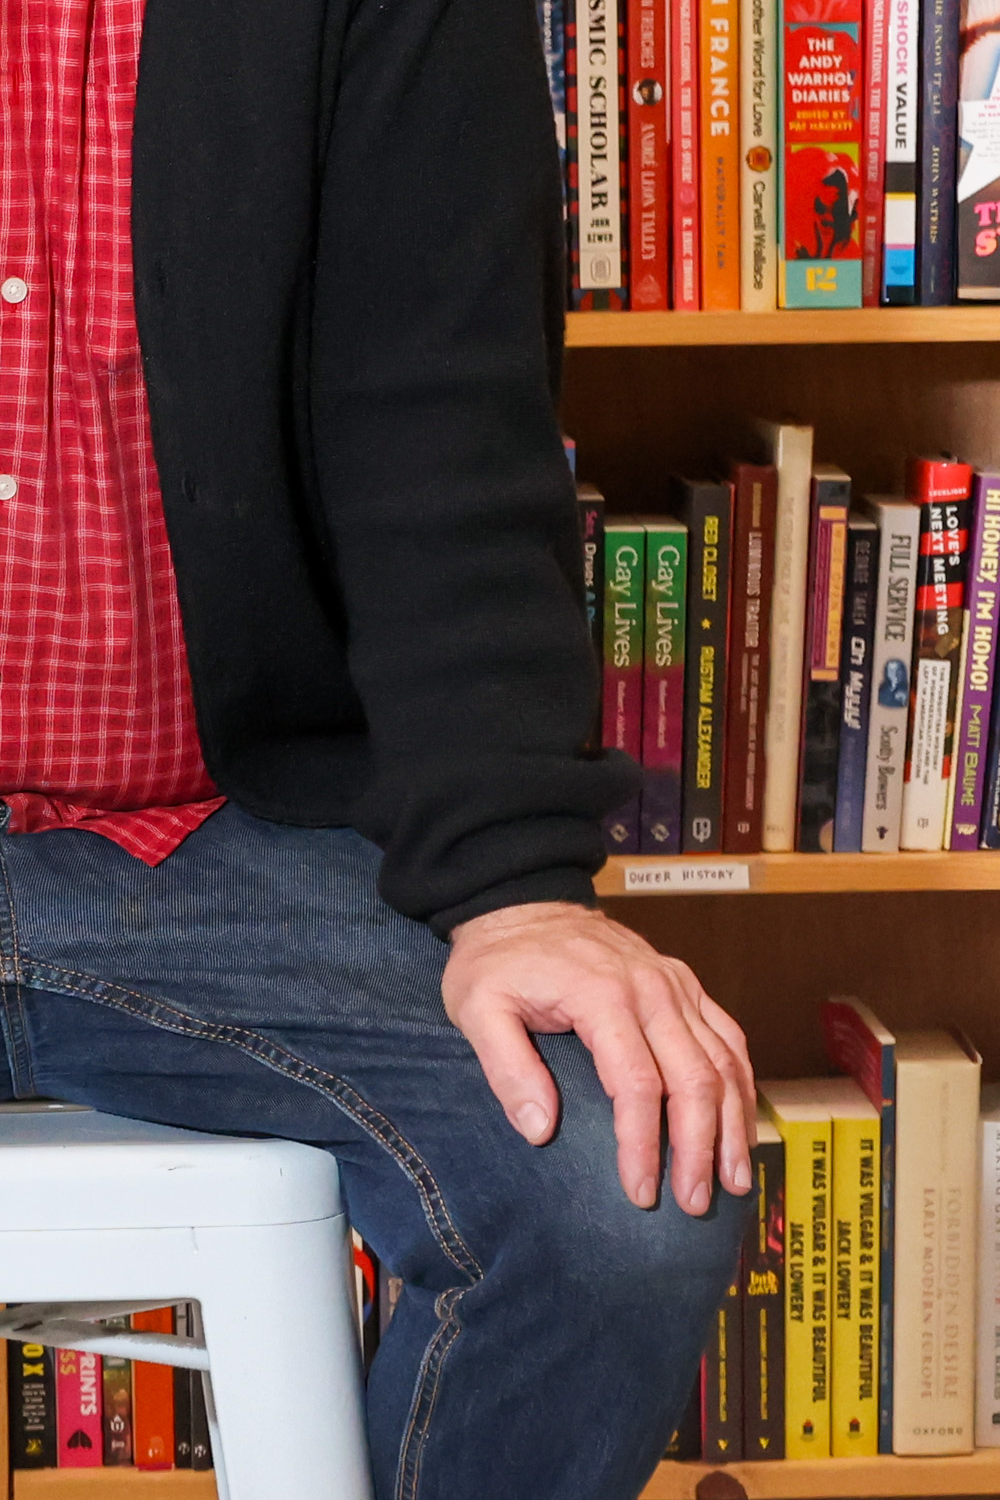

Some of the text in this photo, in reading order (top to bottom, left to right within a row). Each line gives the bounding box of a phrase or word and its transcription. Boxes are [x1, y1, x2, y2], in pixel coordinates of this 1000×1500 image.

[711, 19, 729, 137] FRANCE
[787, 72, 853, 86] WARHOL
[799, 56, 843, 69] ANDY
[806, 38, 835, 51] THE
[895, 0, 908, 149] SHOCK VALUE
[792, 89, 851, 103] DIARIES
[590, 76, 608, 210] SCHOLAR
[946, 505, 960, 566] LOVE'S
[978, 515, 999, 584] HONEY,
[652, 545, 680, 666] Gay Lives
[930, 507, 949, 635] NEXT MEETING
[976, 590, 995, 620] I'M
[970, 627, 992, 692] HOMO!
[961, 705, 981, 806] MATT BAUME
[629, 870, 734, 884] QUEER HISTORY
[837, 1220, 850, 1319] JACK LOWERY
[859, 1138, 873, 1400] IT WAS VULGAR & IT WAS BEAUTIFUL
